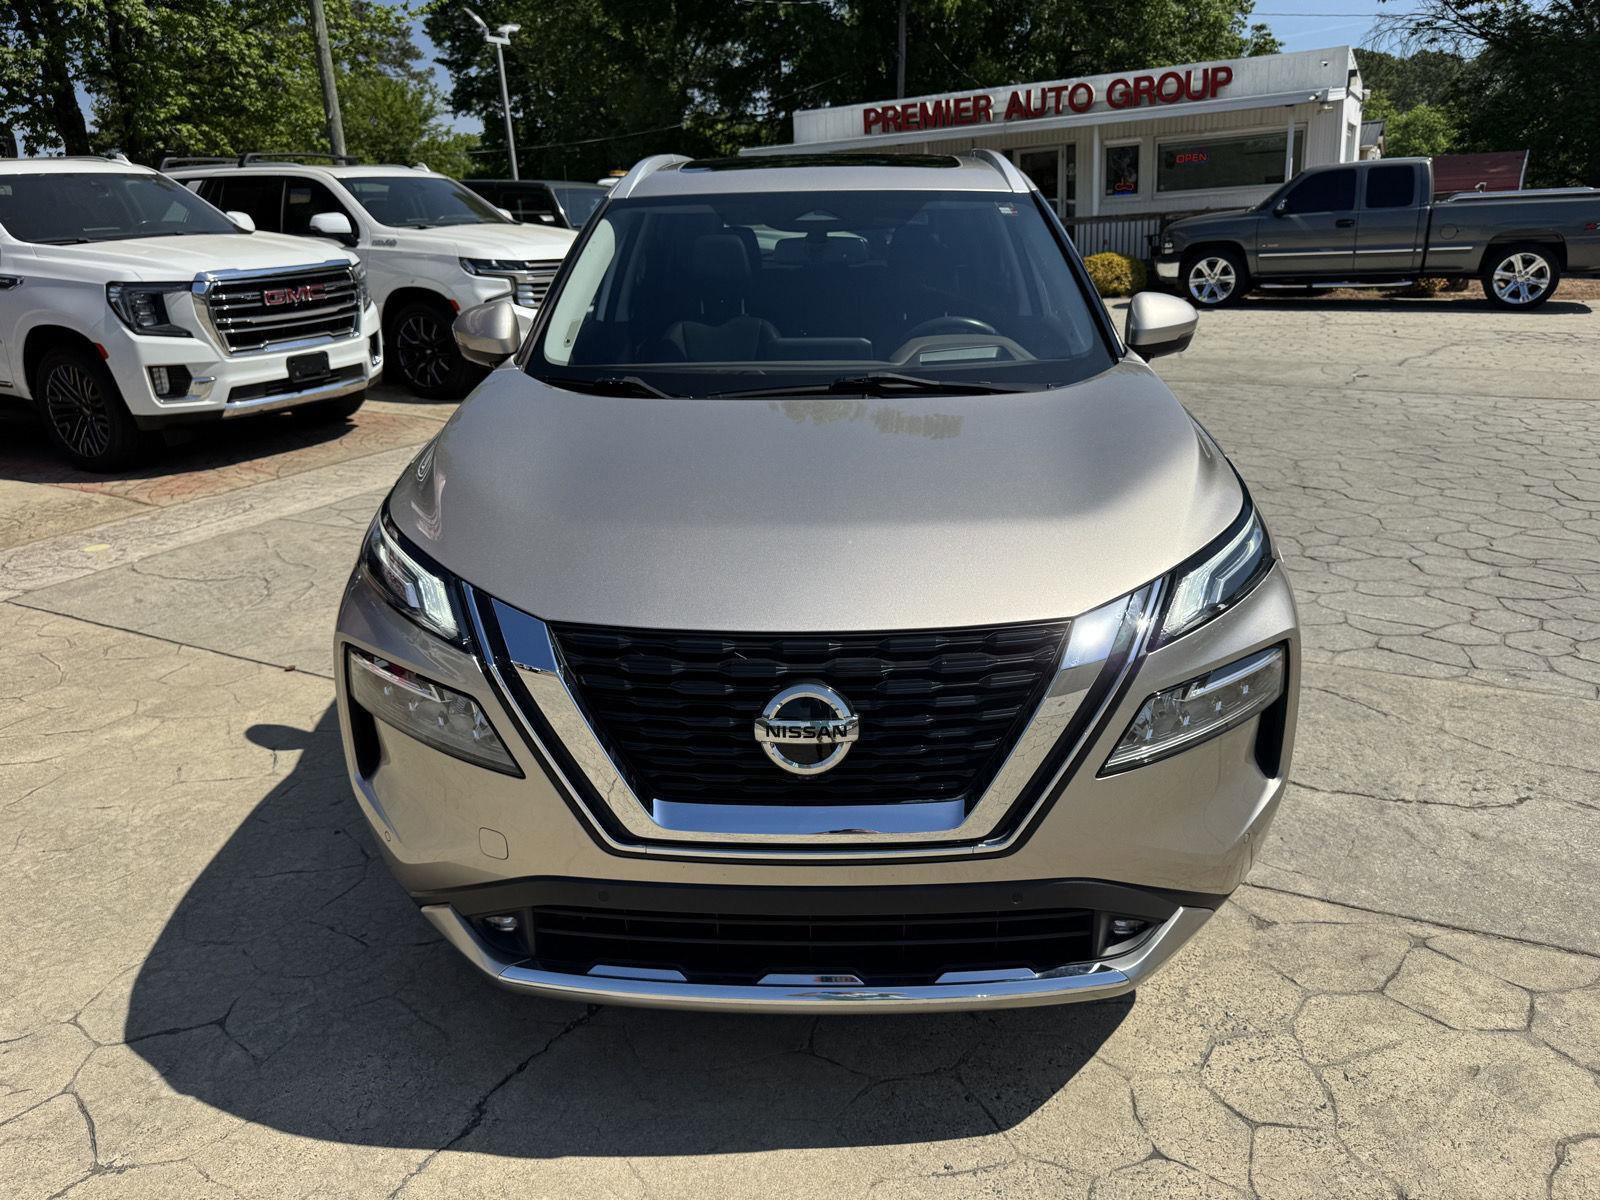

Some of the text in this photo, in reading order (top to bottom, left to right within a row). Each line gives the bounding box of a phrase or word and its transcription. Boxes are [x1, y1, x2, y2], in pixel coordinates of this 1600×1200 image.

[864, 66, 1233, 135] PREMIER AUTO GROUP
[1176, 153, 1207, 164] OPEN
[264, 284, 327, 305] GMC
[766, 725, 848, 738] NISSAN
